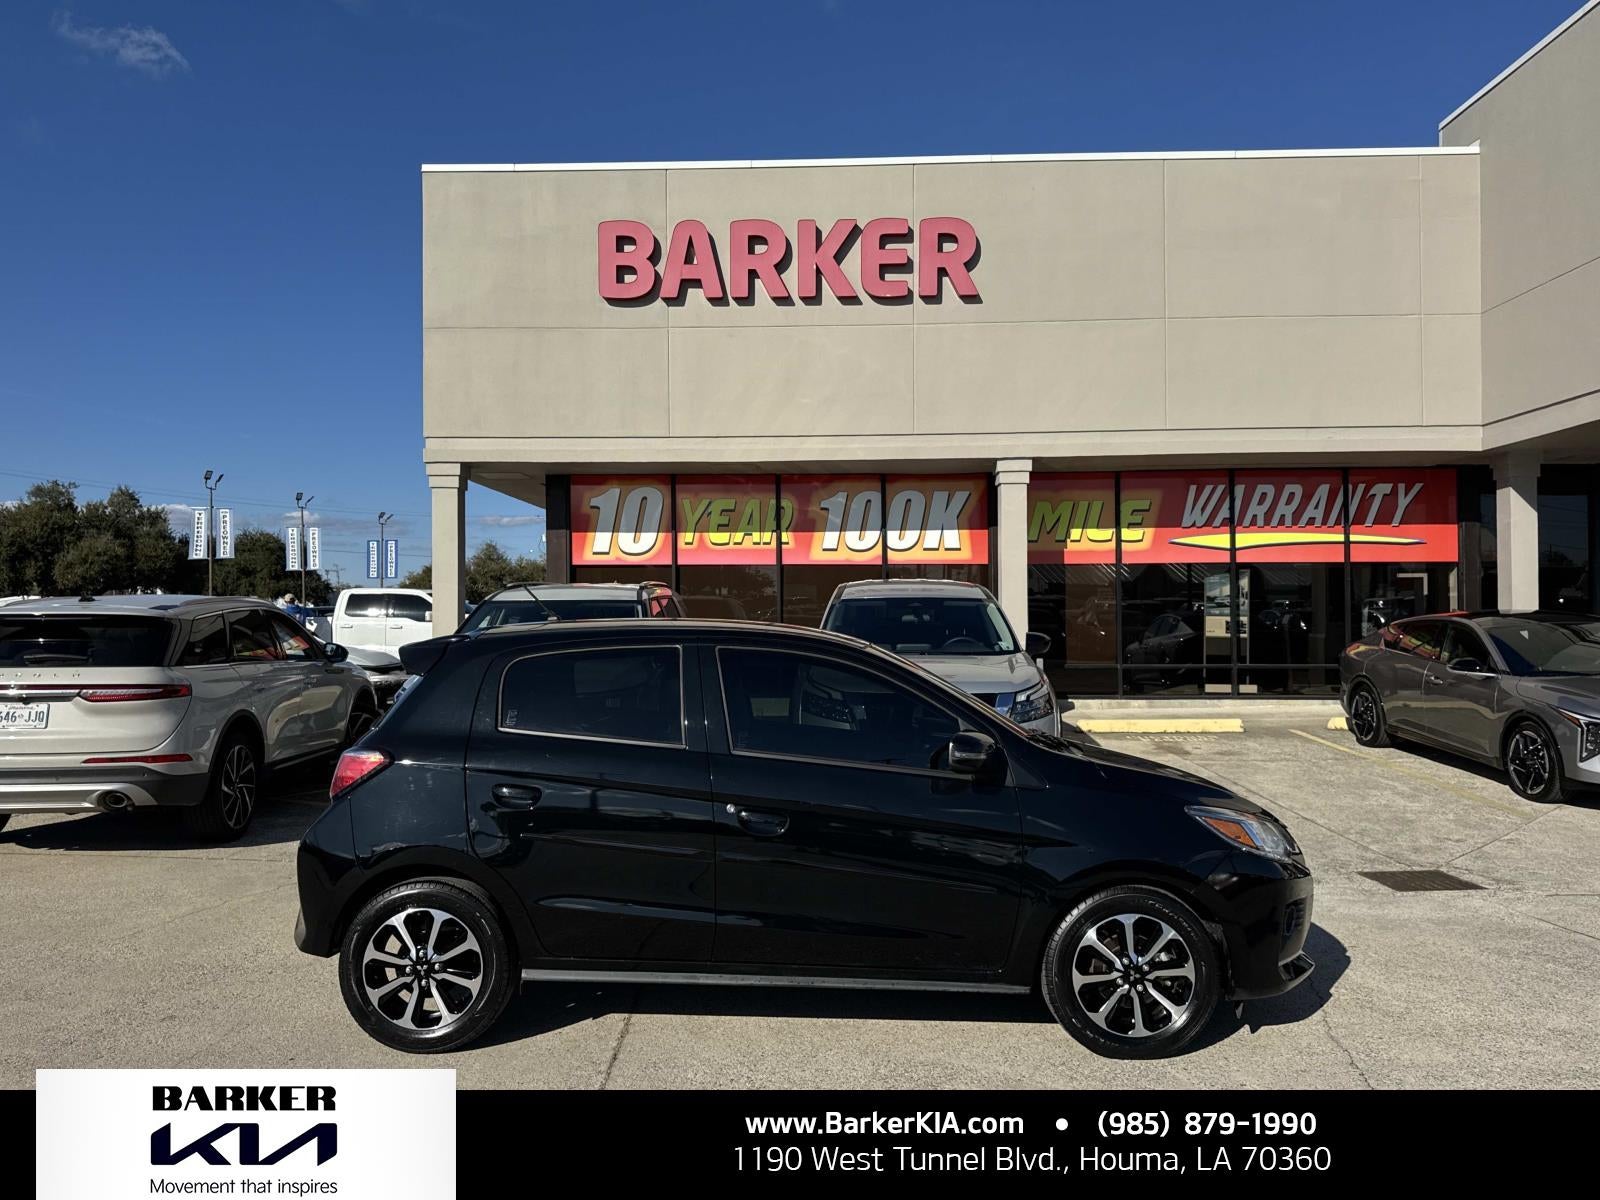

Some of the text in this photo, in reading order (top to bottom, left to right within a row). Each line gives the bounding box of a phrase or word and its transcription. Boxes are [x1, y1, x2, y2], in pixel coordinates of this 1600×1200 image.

[598, 217, 981, 303] BARKER
[590, 482, 1423, 556] 10 YEAR 100K MILE WARRANTY
